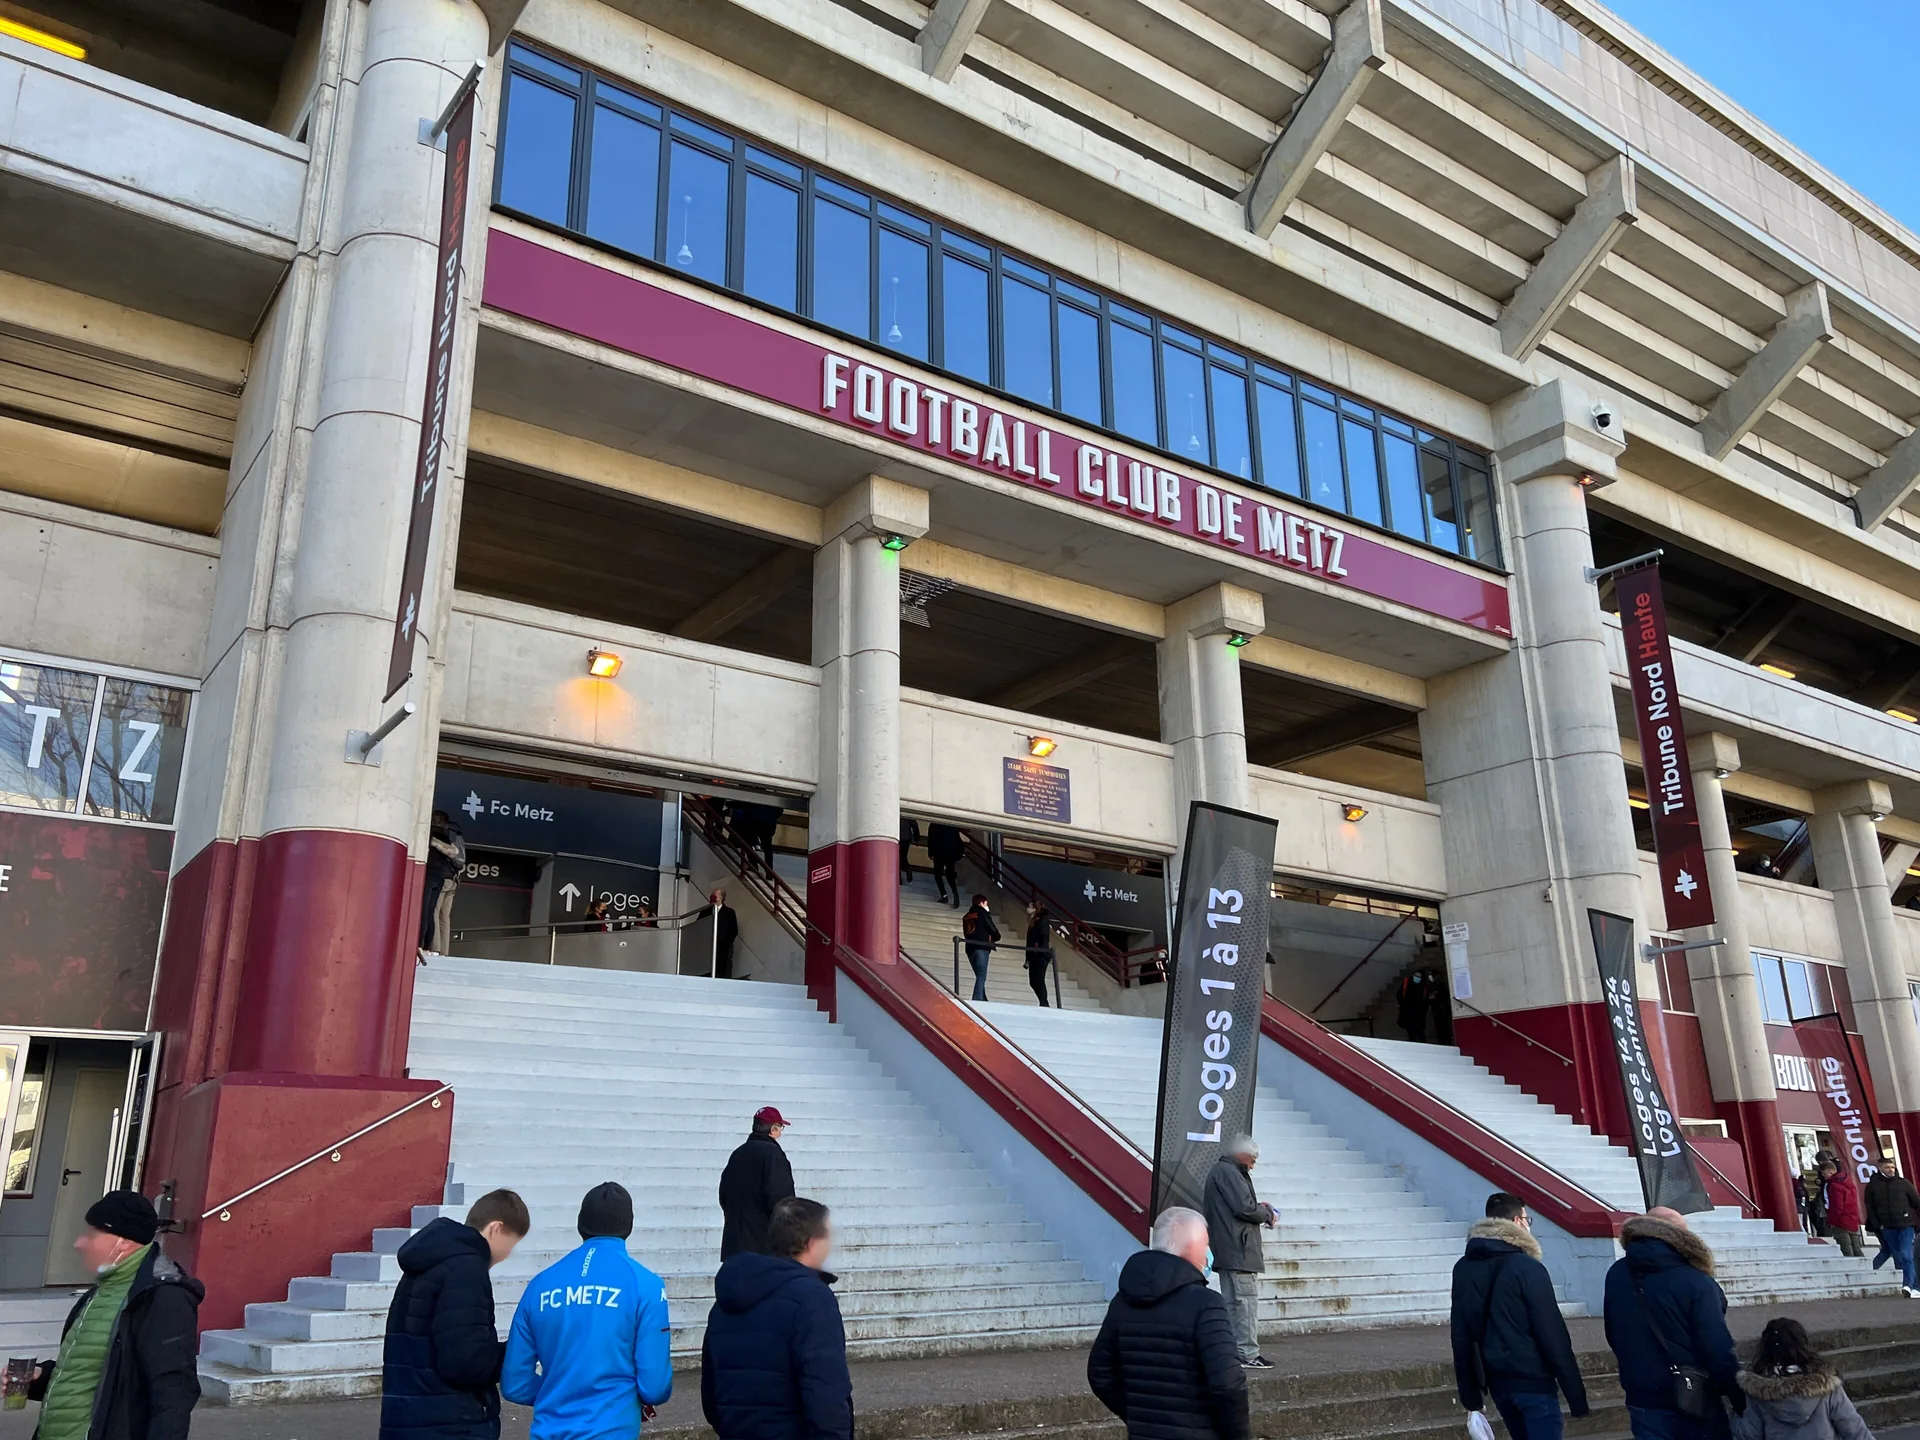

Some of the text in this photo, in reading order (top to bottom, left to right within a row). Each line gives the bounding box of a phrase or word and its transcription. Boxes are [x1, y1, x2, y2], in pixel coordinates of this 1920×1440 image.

[823, 353, 1348, 577] FOOTBALL CLUB DE METZ
[1634, 592, 1683, 815] Tribune Nord Haute
[490, 800, 554, 821] Fc Metz
[1100, 886, 1138, 903] Fc Metz
[1187, 887, 1244, 1142] Loges 1 à 13
[1606, 976, 1658, 1156] Loges 14 à 24
[1620, 979, 1681, 1157] Loge centrale
[540, 1285, 622, 1312] FC METZ
